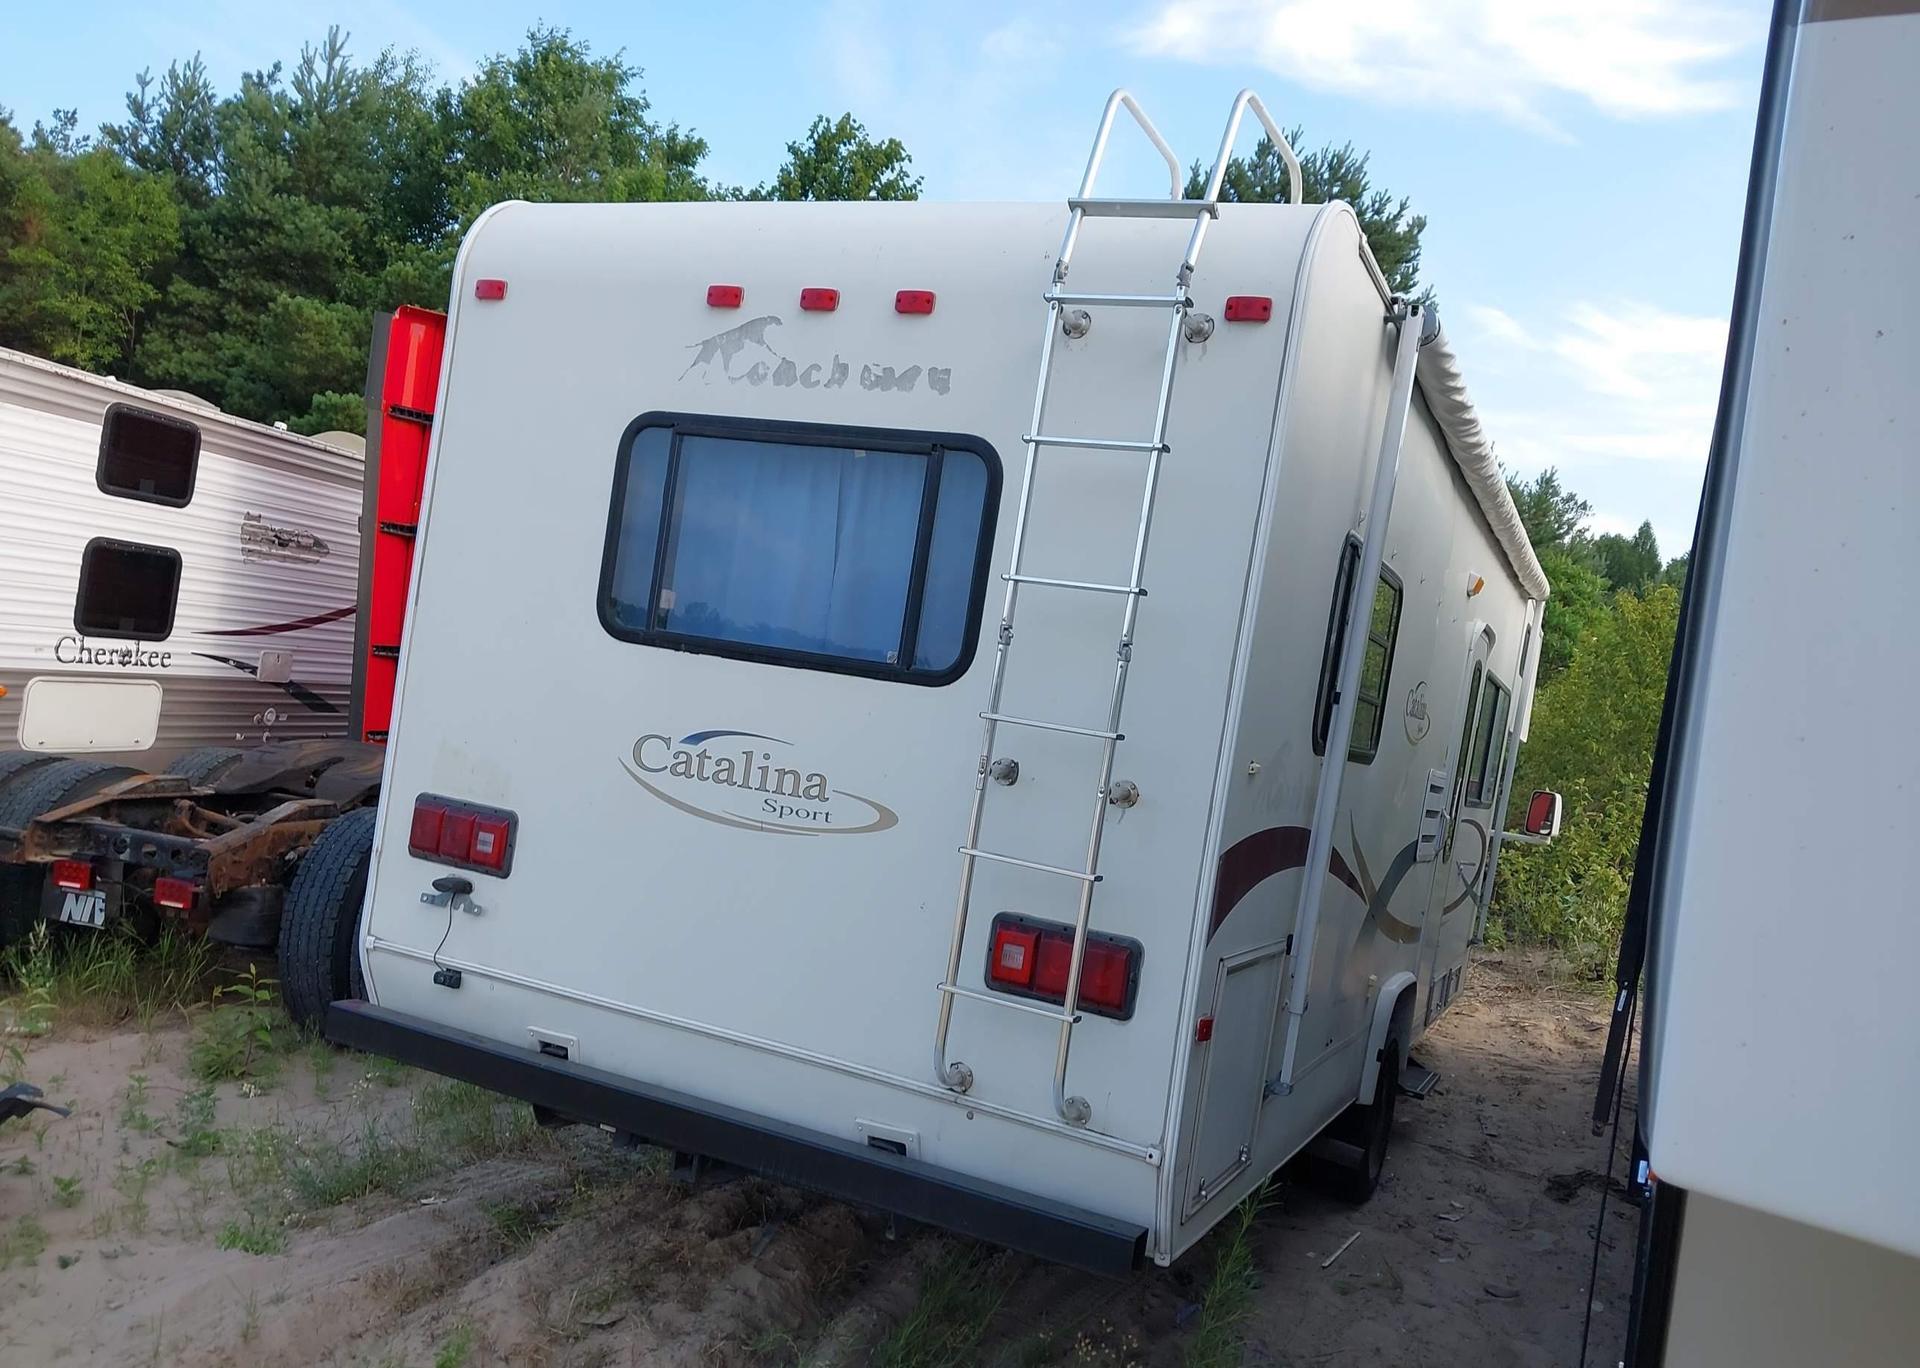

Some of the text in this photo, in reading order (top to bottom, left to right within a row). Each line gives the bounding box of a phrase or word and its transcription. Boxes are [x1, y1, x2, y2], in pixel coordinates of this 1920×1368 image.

[54, 635, 172, 668] Cherokee
[632, 733, 830, 802] Catalina
[761, 798, 833, 824] Sport
